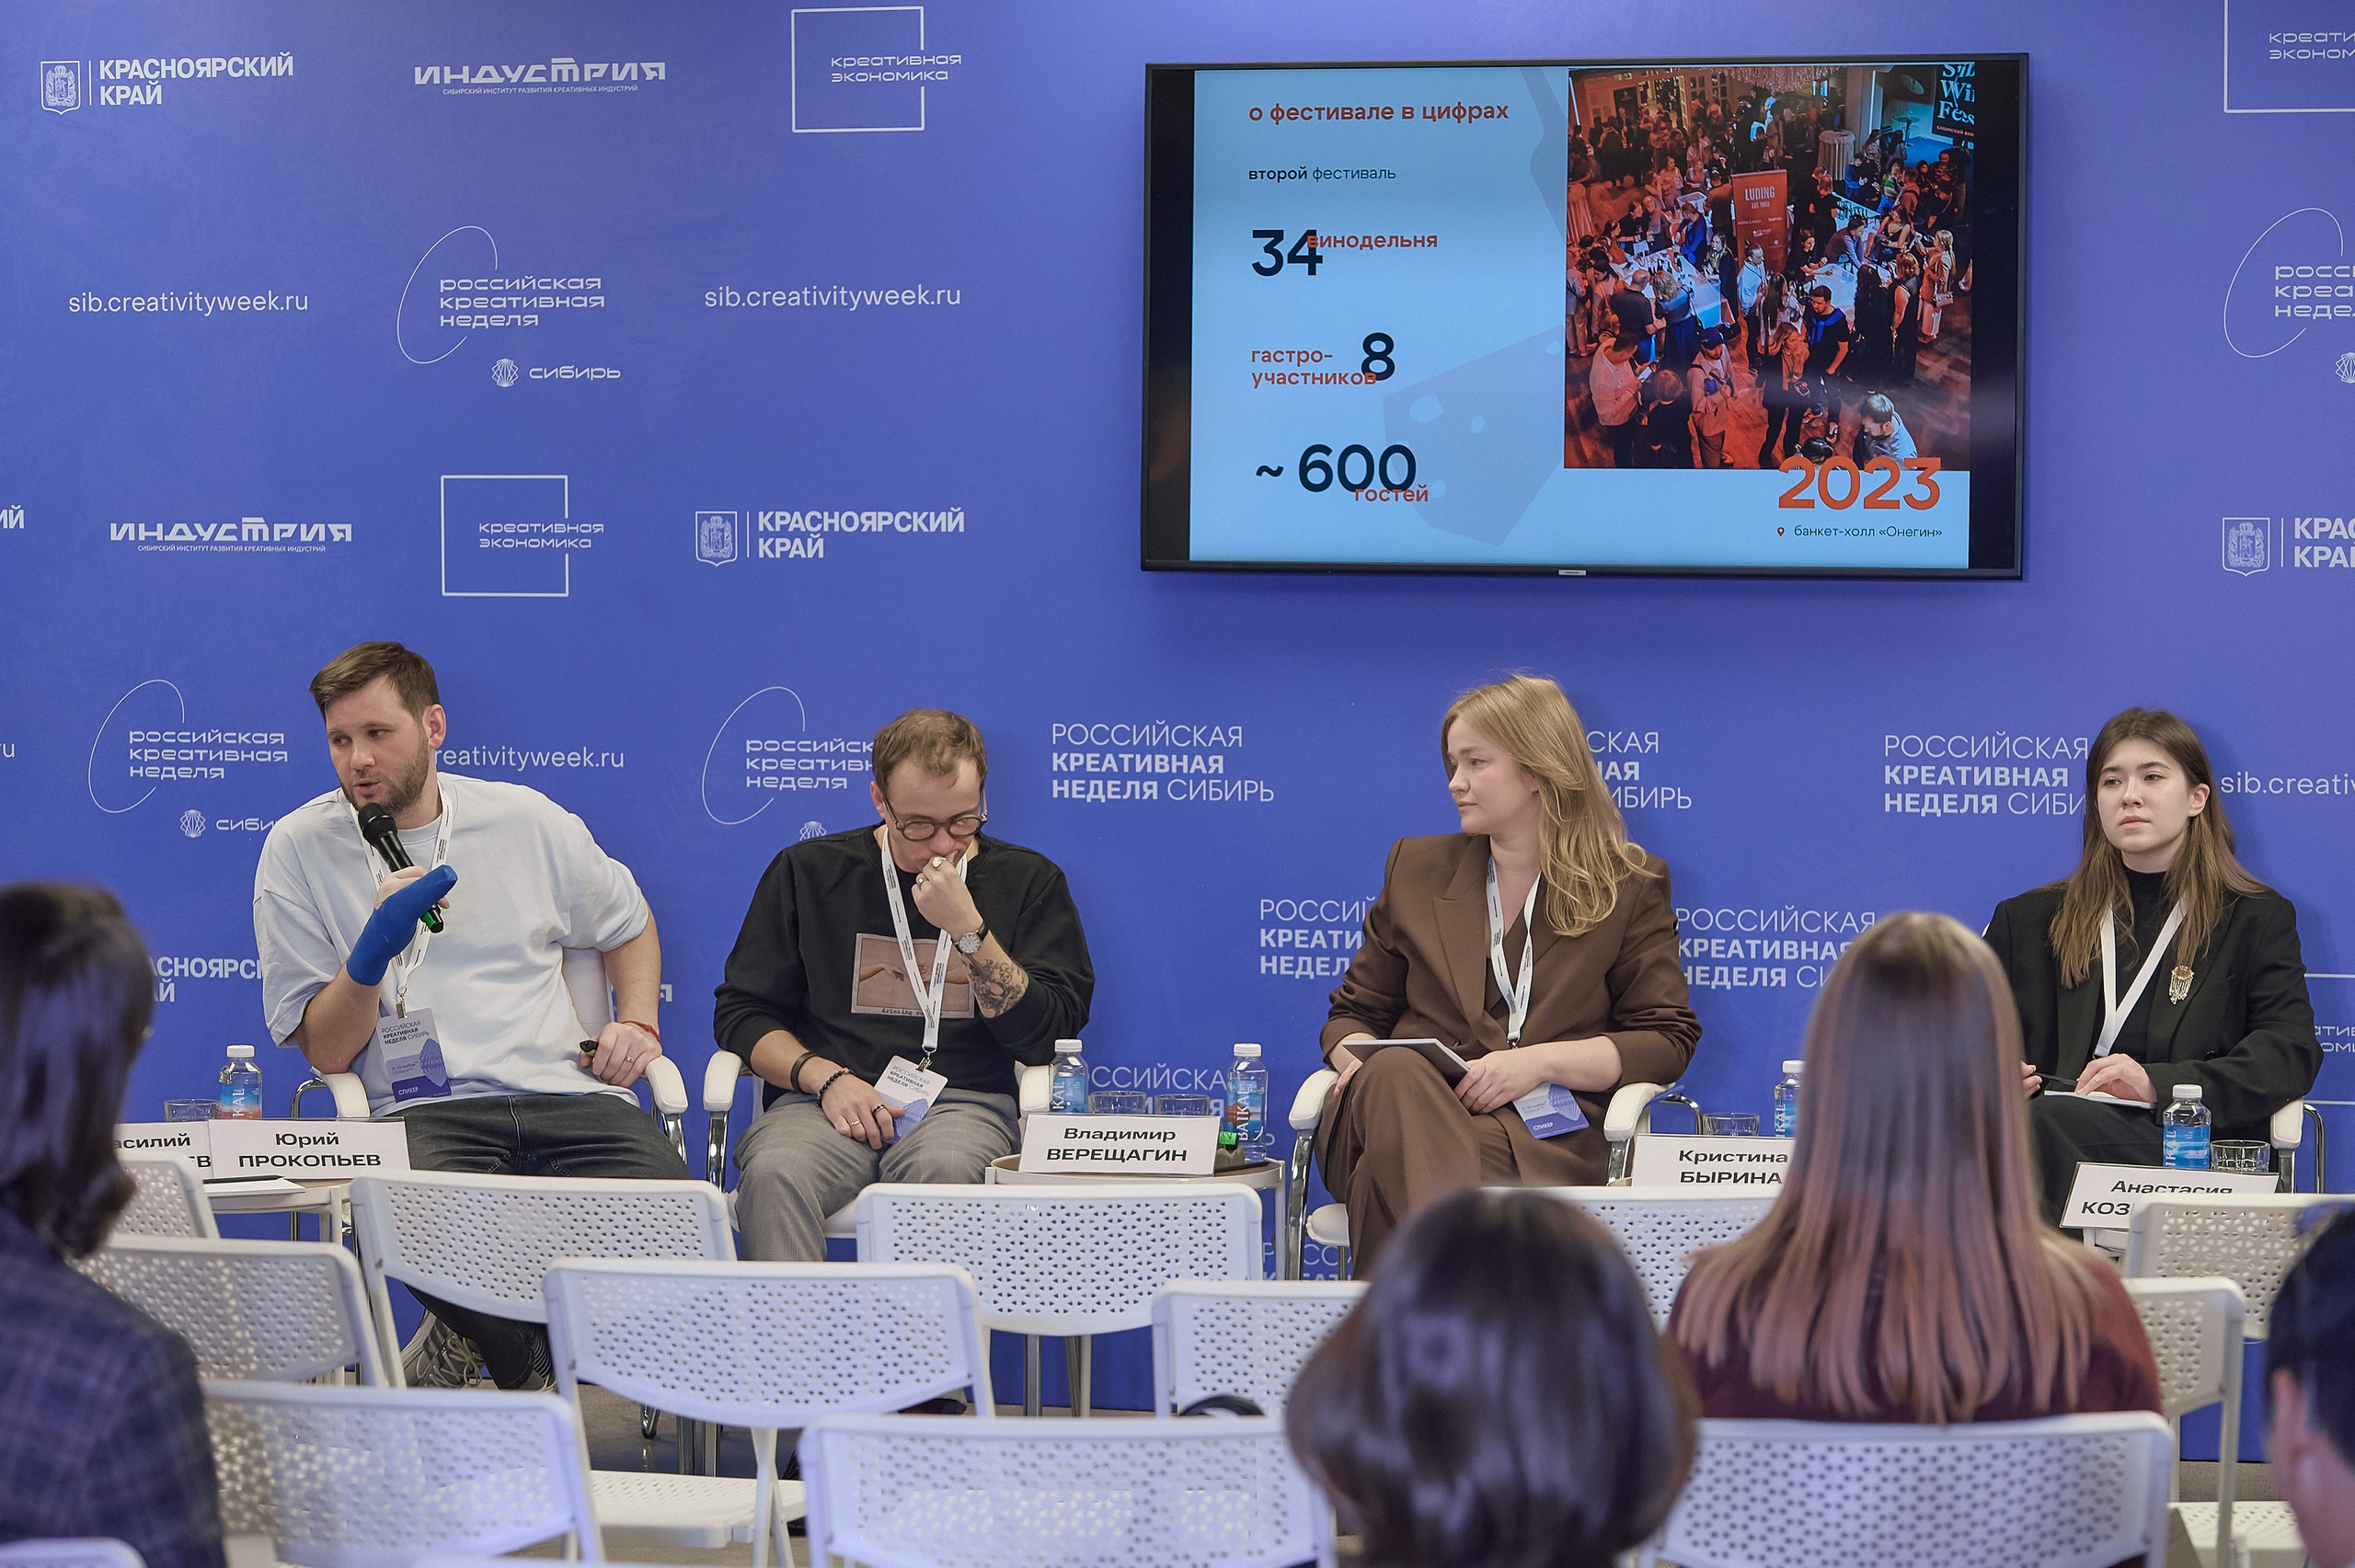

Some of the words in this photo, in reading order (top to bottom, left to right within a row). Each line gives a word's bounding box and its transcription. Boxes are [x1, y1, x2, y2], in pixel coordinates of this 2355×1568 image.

[2269, 33, 2355, 44] креати
[832, 55, 960, 68] креативная
[2269, 49, 2355, 59] эконом
[100, 52, 293, 79] КРАСНОЯРСКИЙ
[415, 58, 665, 84] ИНДУСТРИЯ
[832, 71, 948, 82] экономика
[100, 81, 161, 105] КРАЙ
[598, 85, 638, 93] ИНДУСТРИЙ
[1248, 106, 1263, 121] о
[1269, 103, 1395, 125] фестивале
[1402, 107, 1415, 120] в
[1422, 101, 1509, 124] цифрах
[1248, 166, 1307, 182] второй
[1313, 166, 1396, 183] фестиваль
[1744, 186, 1775, 201] LUDING
[1306, 235, 1438, 250] винодельня
[1251, 229, 1324, 277] 34
[441, 276, 601, 292] российская
[69, 291, 307, 315] sib.creativityweek.ru
[441, 296, 603, 310] креативная
[706, 284, 959, 311] sib.creativityweek.ru
[2275, 304, 2355, 320] неде
[441, 315, 538, 328] неделя
[1251, 349, 1333, 367] гастро-
[1361, 332, 1396, 382] 8
[530, 365, 620, 380] сибирь
[1251, 372, 1377, 389] участников
[1298, 444, 1417, 493] 600
[1778, 456, 1942, 510] 2023
[1354, 485, 1429, 502] гостей
[479, 523, 603, 533] креативная
[759, 508, 964, 532] КРАСНОЯРСКИЙ
[110, 518, 351, 541] ИНДУСТРИЯ
[1794, 524, 1876, 538] банкет-холл
[1878, 525, 1943, 538] «Онегин»
[137, 544, 176, 553] СИБИРСКИЙ
[177, 544, 209, 553] ИНСТИТУТ
[210, 544, 243, 553] РАЗВИТИЯ
[244, 544, 287, 553] КРЕАТИВНЫХ
[287, 544, 326, 553] ИНДУСТРИЙ
[480, 539, 591, 547] экономика
[759, 533, 823, 557] КРАЙ
[130, 729, 283, 744] российская
[1053, 720, 1241, 747] РОССИЙСКАЯ
[746, 738, 874, 753] российск
[1885, 731, 2088, 760] РОССИЙСКАЯ
[131, 749, 287, 761] креативная
[434, 746, 625, 772] reativityweek.ru
[1053, 753, 1223, 773] КРЕАТИВНАЯ
[131, 767, 224, 780] неделя
[746, 758, 873, 772] креативн
[746, 776, 847, 791] неделя
[1885, 765, 2068, 787] КРЕАТИВНАЯ
[1053, 780, 1157, 802] НЕДЕЛЯ
[1168, 779, 1273, 801] СИБИРЬ
[1612, 785, 1692, 809] ИБИРЬ
[1885, 793, 1997, 817] НЕДЕЛЯ
[2007, 792, 2086, 816] СИБИ
[216, 818, 275, 831] сиби
[1675, 905, 1876, 933] РОССИЙСКАЯ
[1260, 928, 1362, 949] КРЕАТИ
[1260, 956, 1350, 979] НЕДЕЛ
[397, 1086, 419, 1095] СПИКЕР
[1052, 1081, 1065, 1110] KAL
[232, 1088, 245, 1117] KAL
[1236, 1085, 1250, 1141] BAIKAL
[114, 1132, 191, 1150] асилий
[276, 1132, 339, 1148] Юрий
[1064, 1128, 1176, 1142] Владимир
[239, 1155, 381, 1167] ПРОКОПЬЕВ
[1047, 1149, 1187, 1162] ВЕРЕЩАГИН
[1679, 1150, 1788, 1165] Кристина
[1681, 1172, 1782, 1184] БЫРИНА
